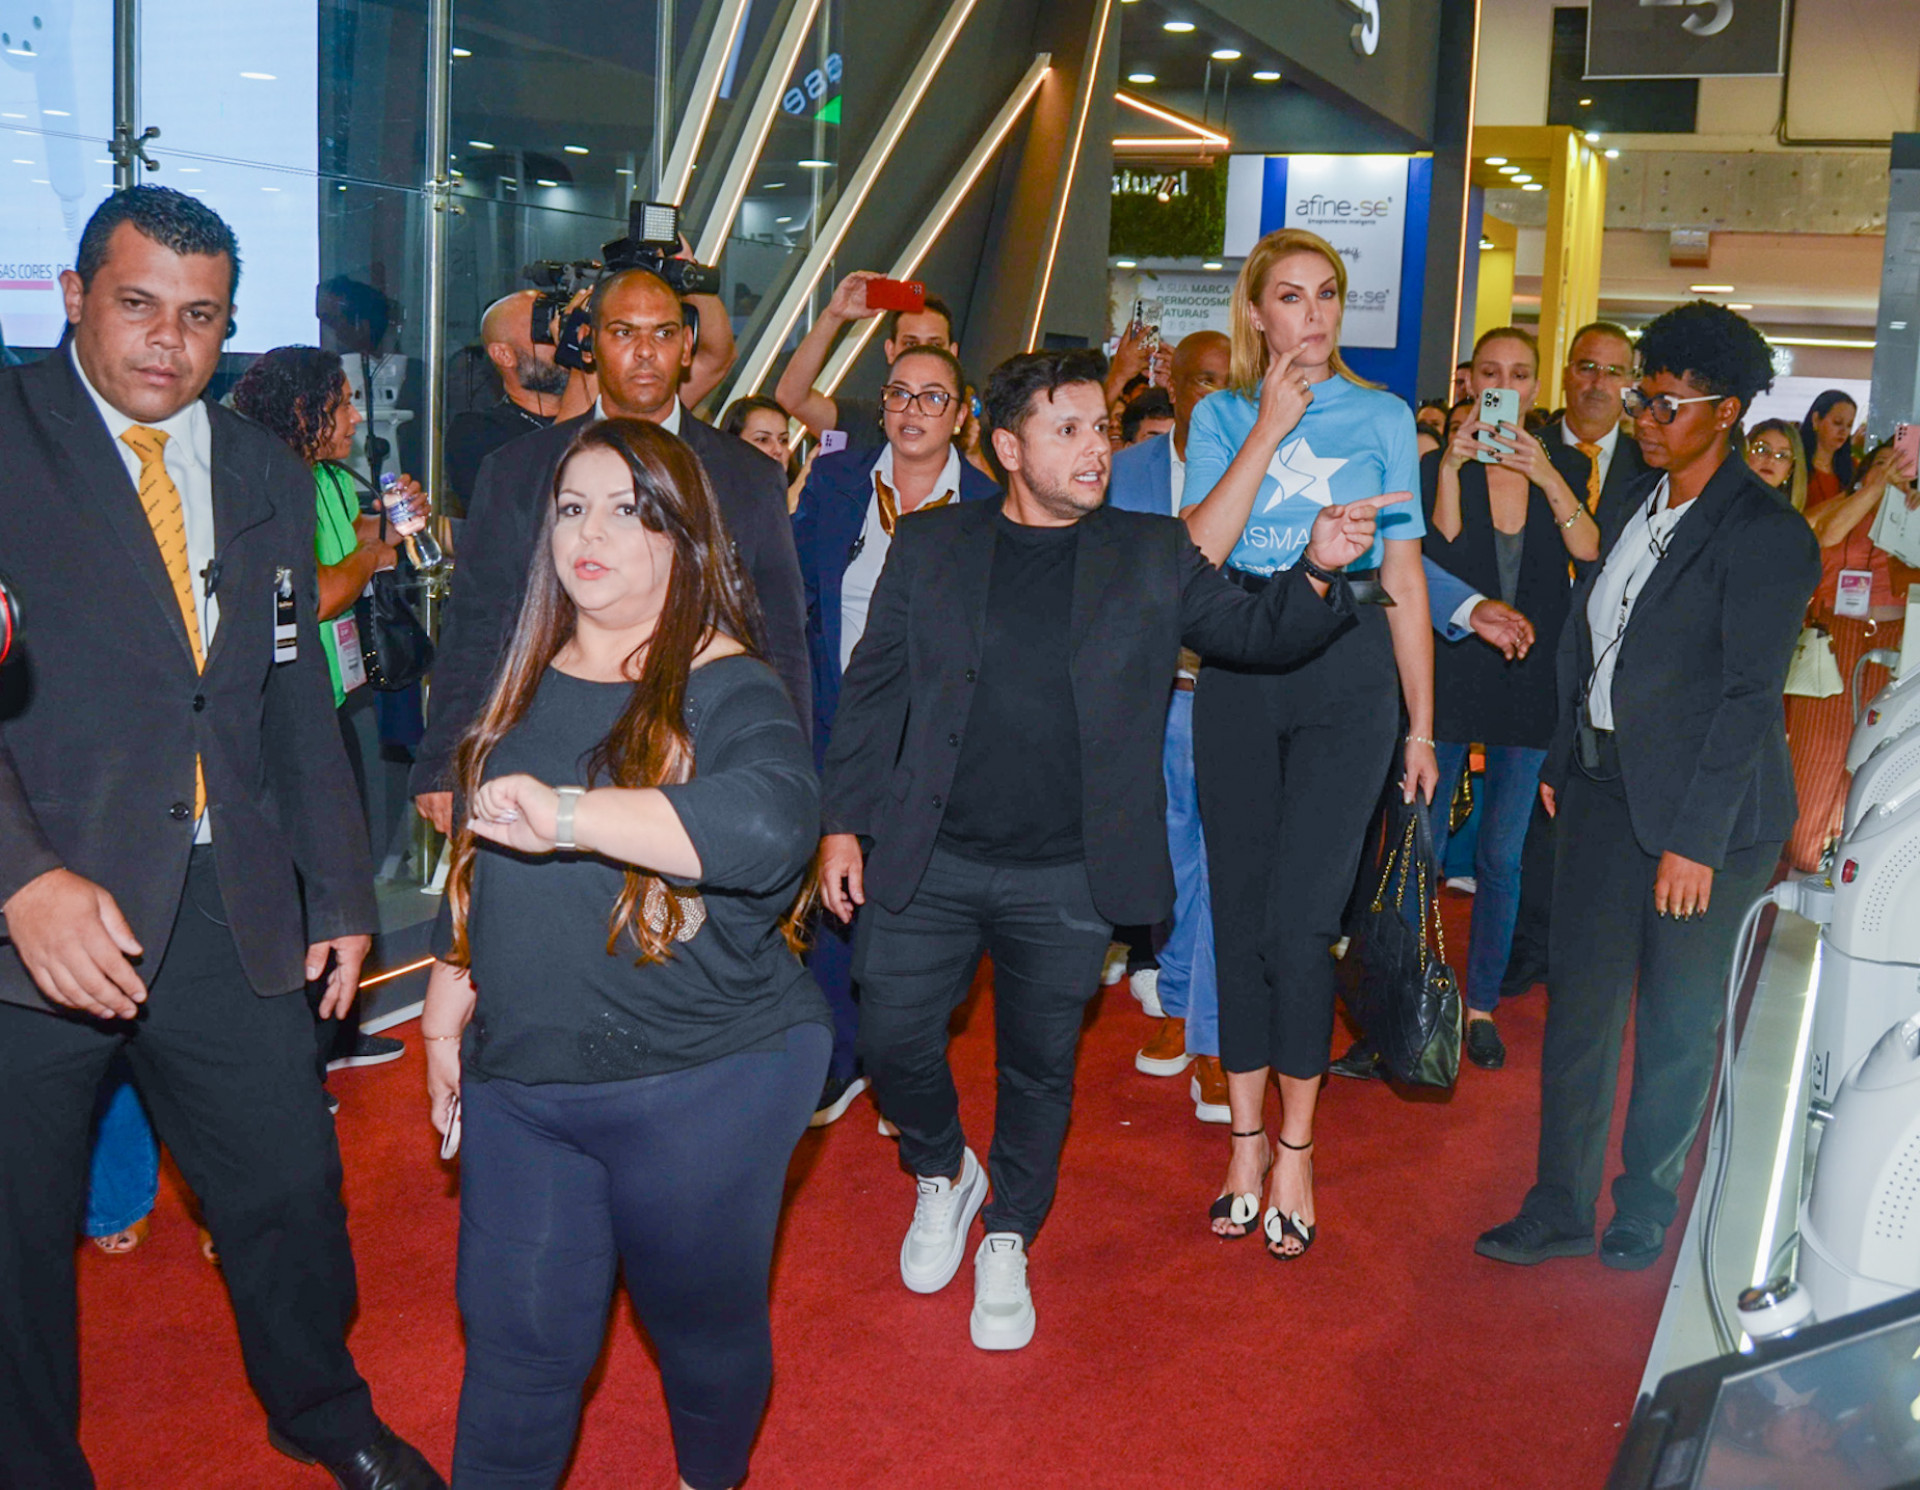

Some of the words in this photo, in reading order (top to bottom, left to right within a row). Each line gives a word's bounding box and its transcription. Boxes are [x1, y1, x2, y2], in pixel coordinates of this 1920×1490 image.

[1295, 194, 1389, 217] afine-se
[18, 264, 53, 279] CORES
[1167, 283, 1189, 293] SUA
[1191, 284, 1231, 294] MARCA
